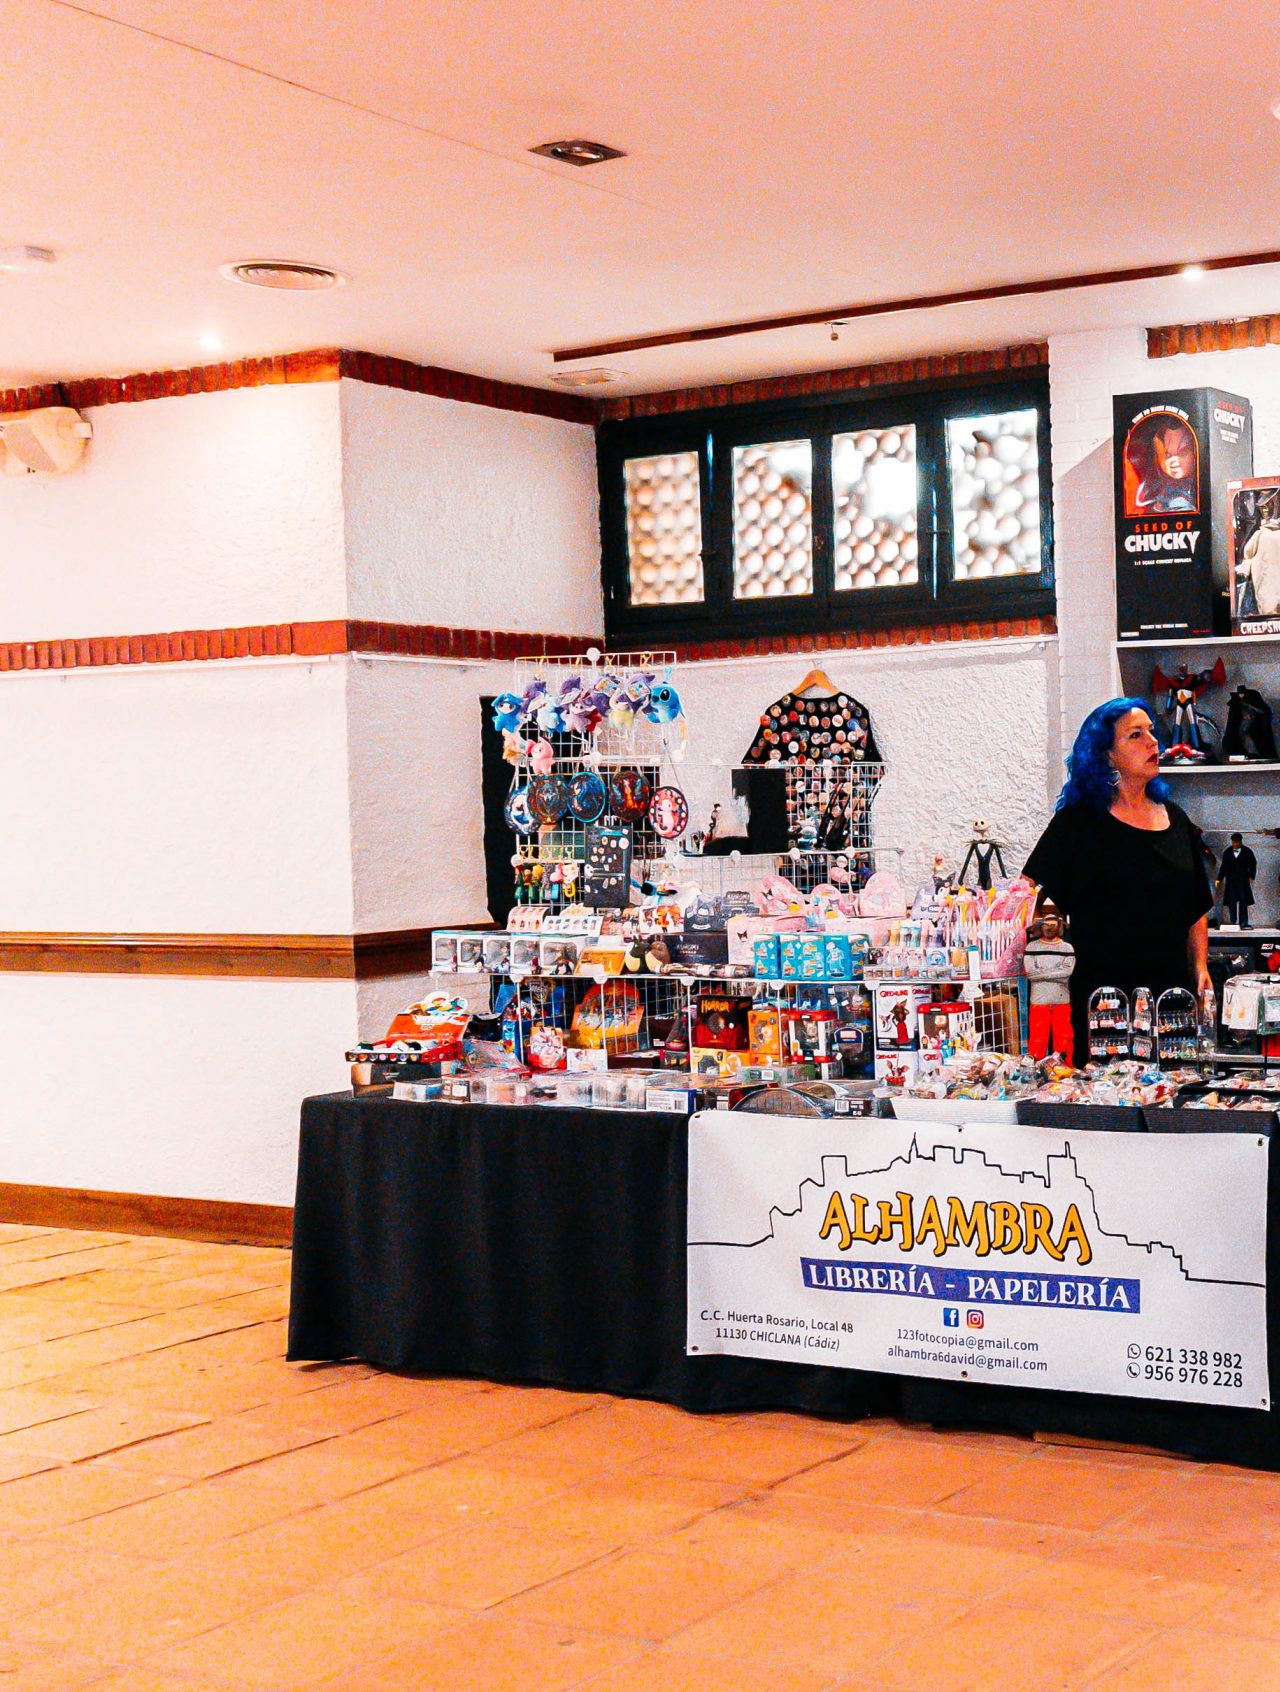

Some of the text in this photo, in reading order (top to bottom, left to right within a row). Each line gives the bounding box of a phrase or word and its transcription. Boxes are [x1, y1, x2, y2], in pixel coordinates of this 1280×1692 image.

[1214, 408, 1246, 432] CHUCKY
[1135, 520, 1192, 533] SEED OF
[1124, 531, 1200, 554] CHUCKY
[819, 1190, 1093, 1265] ALHAMBRA
[808, 1264, 936, 1296] LIBRERÍA
[967, 1276, 1131, 1309] PAPELERÍA
[700, 1310, 854, 1333] C.C. Huerta Rosario, Local 48
[716, 1328, 840, 1351] 11130 CHICLANA (Cádiz)
[897, 1329, 1039, 1351] 123fotocopia@gmail.com
[888, 1346, 1048, 1371] alhambra6david@gmail.com
[1146, 1346, 1242, 1369] 621 338 982
[1144, 1364, 1242, 1388] 956 976 228
